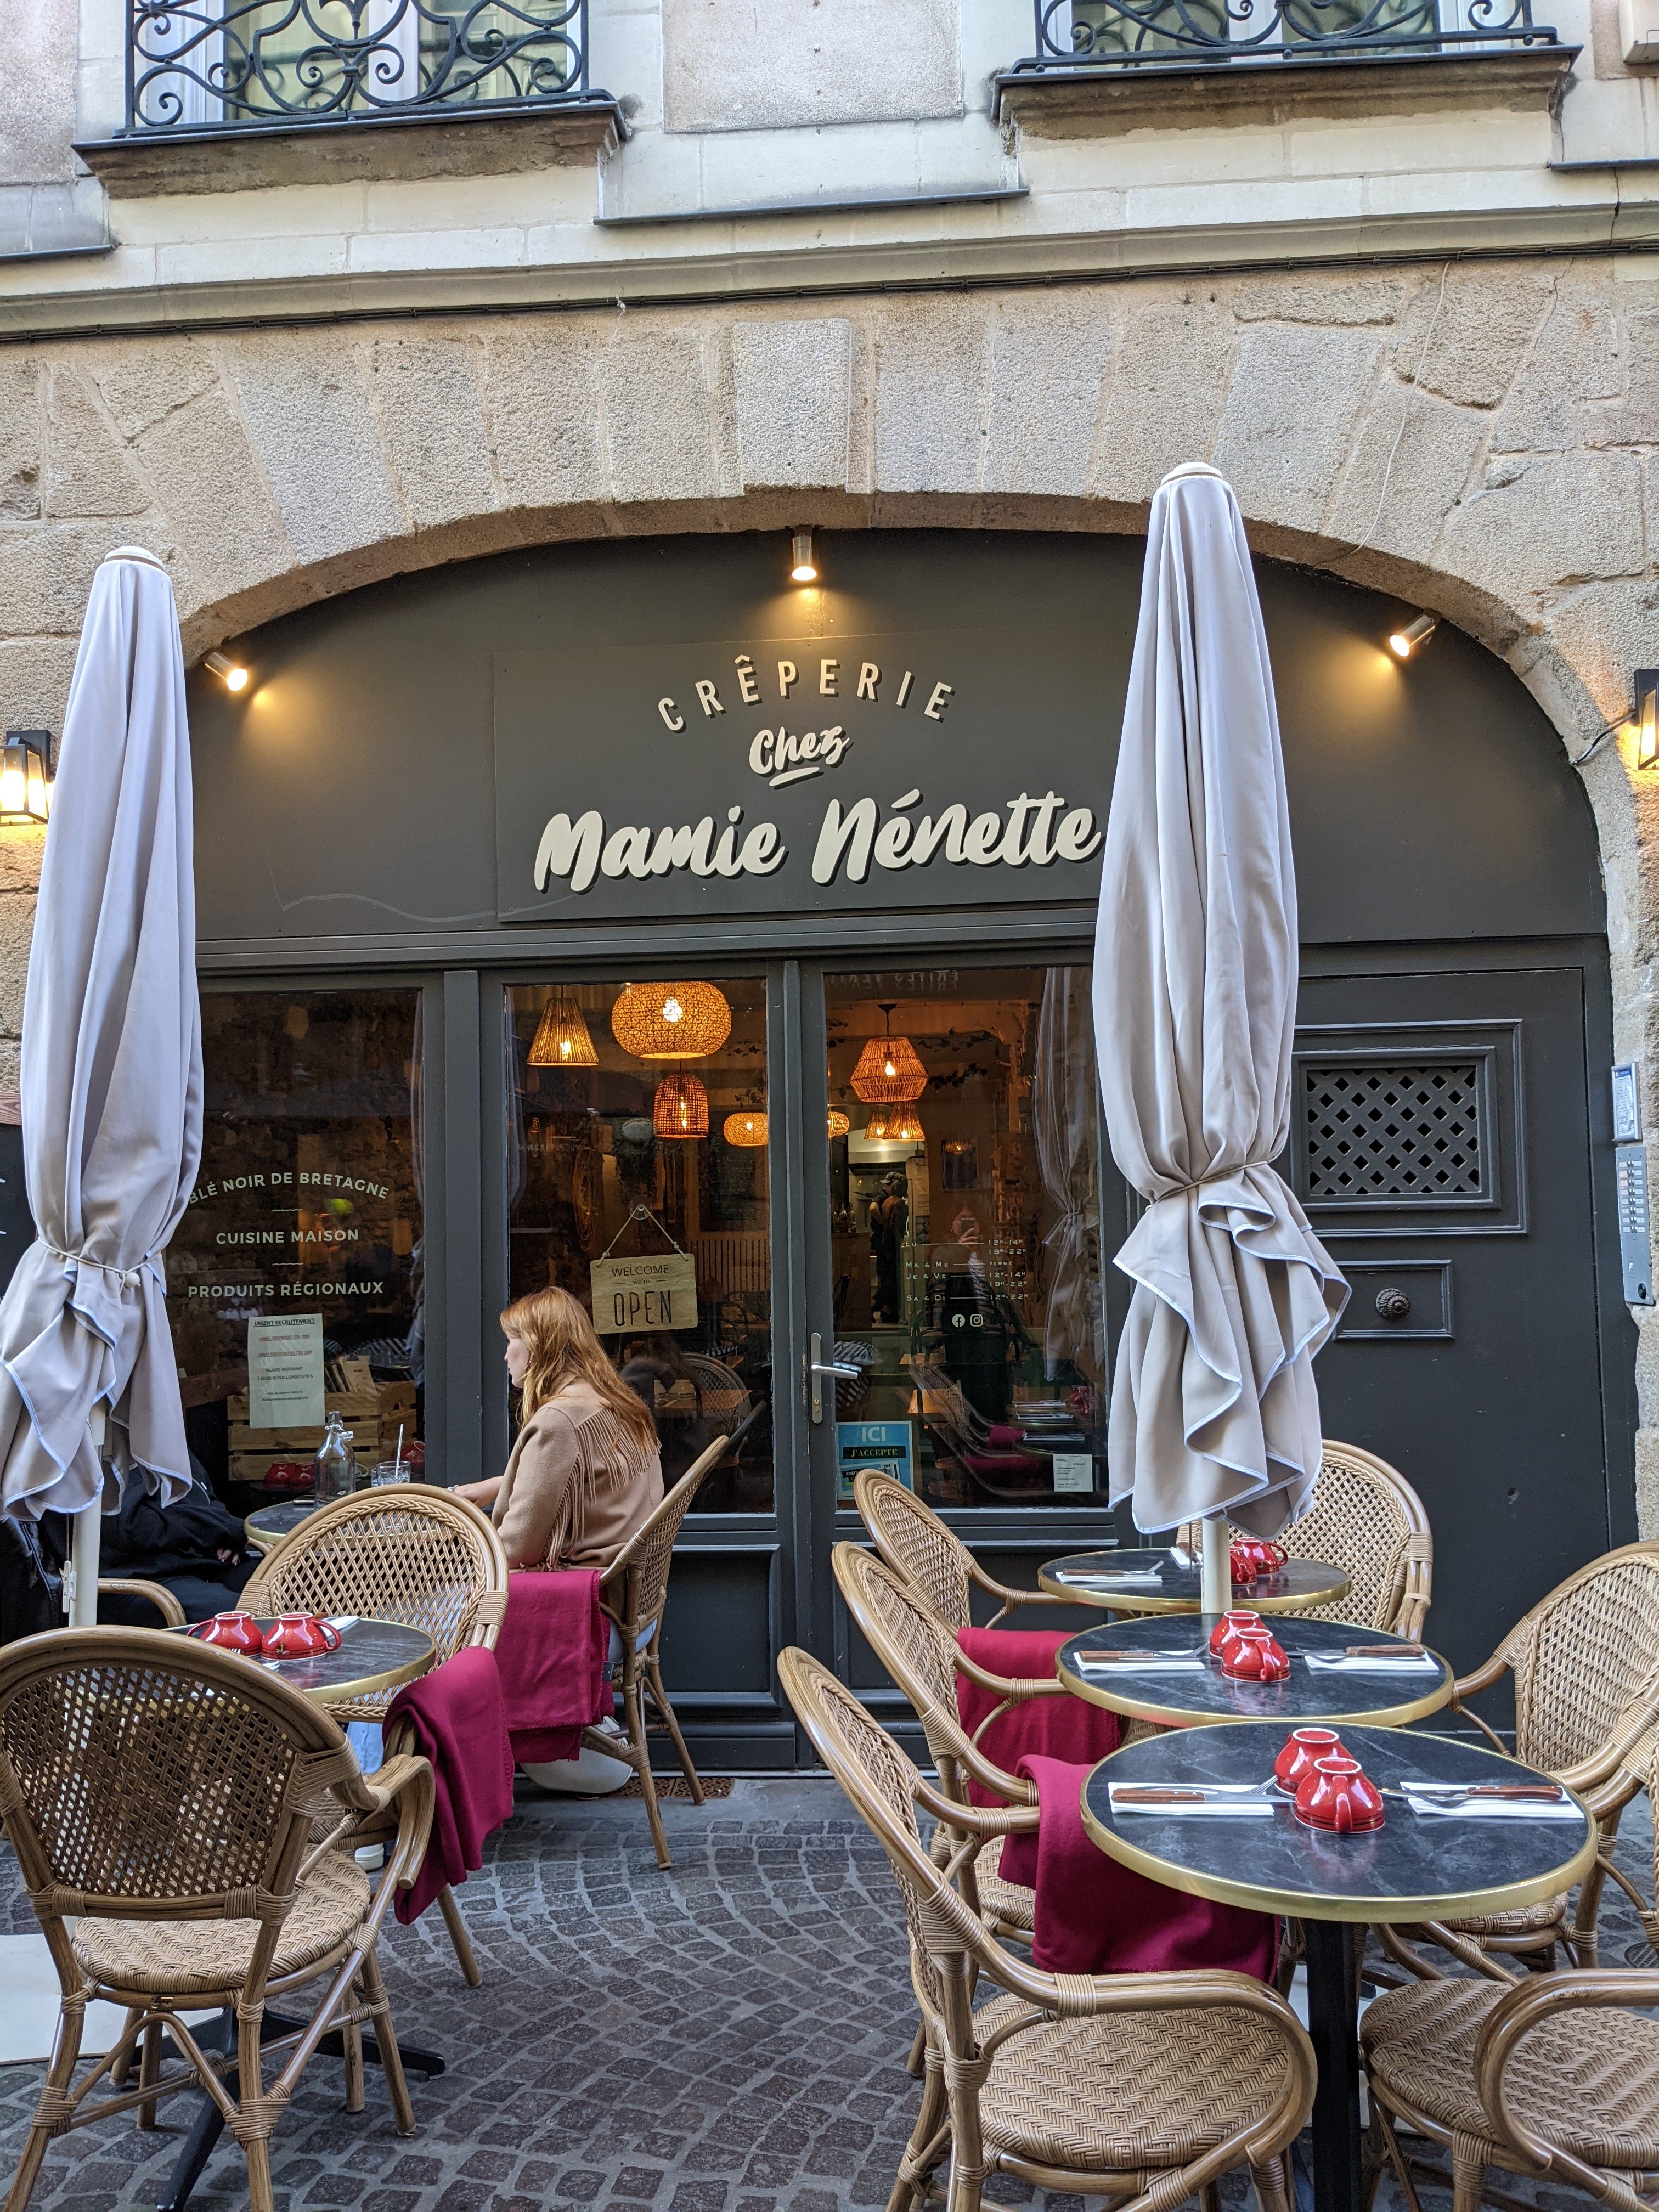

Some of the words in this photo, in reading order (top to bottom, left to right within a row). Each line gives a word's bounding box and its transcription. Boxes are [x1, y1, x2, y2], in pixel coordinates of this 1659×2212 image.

[658, 654, 953, 732] CRÊPERIE
[749, 725, 851, 776] Chez
[533, 805, 788, 894] Mamie
[810, 788, 1102, 887] Nénette
[190, 1181, 218, 1204] BLÉ
[222, 1174, 264, 1192] NOIR
[271, 1172, 293, 1184] DE
[300, 1172, 390, 1200] BRETAGNE
[216, 1231, 285, 1245] CUISINE
[291, 1229, 359, 1243] MAISON
[611, 1264, 669, 1277] WELCOME
[188, 1285, 274, 1298] PRODUITS
[280, 1281, 383, 1296] RÉGIONAUX
[613, 1290, 672, 1327] OPEN
[861, 1426, 886, 1442] ICI
[851, 1448, 898, 1458] J'ACCEPTE
